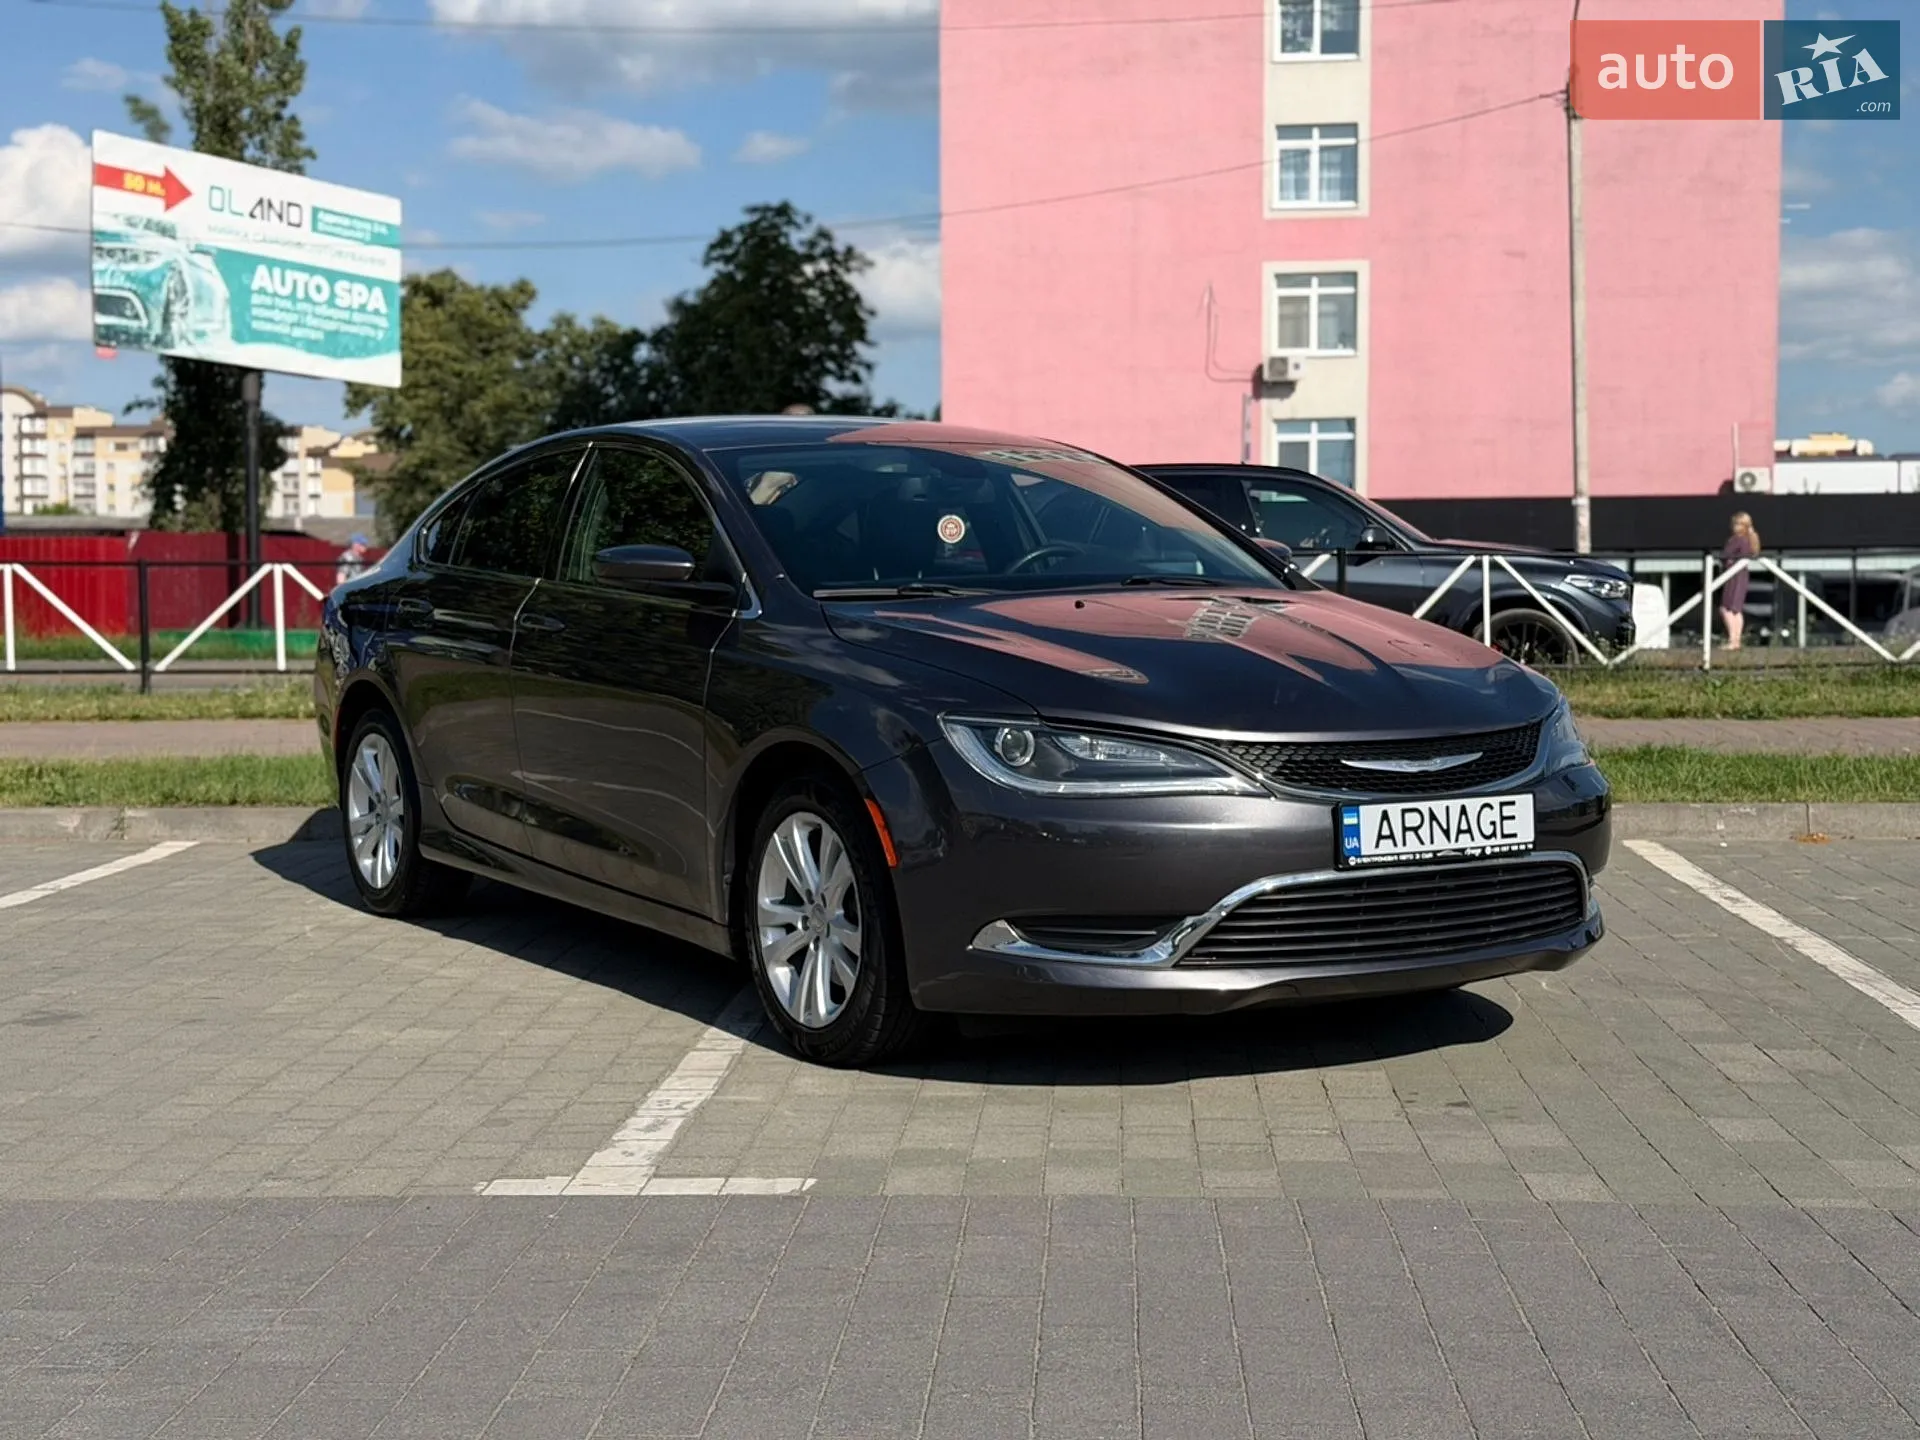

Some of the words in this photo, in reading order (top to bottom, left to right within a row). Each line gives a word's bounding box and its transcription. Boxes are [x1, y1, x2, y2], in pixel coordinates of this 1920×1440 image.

[250, 263, 331, 305] AUTO
[333, 279, 389, 314] SPA
[1344, 837, 1360, 850] UA
[1374, 800, 1518, 849] ARNAGE
